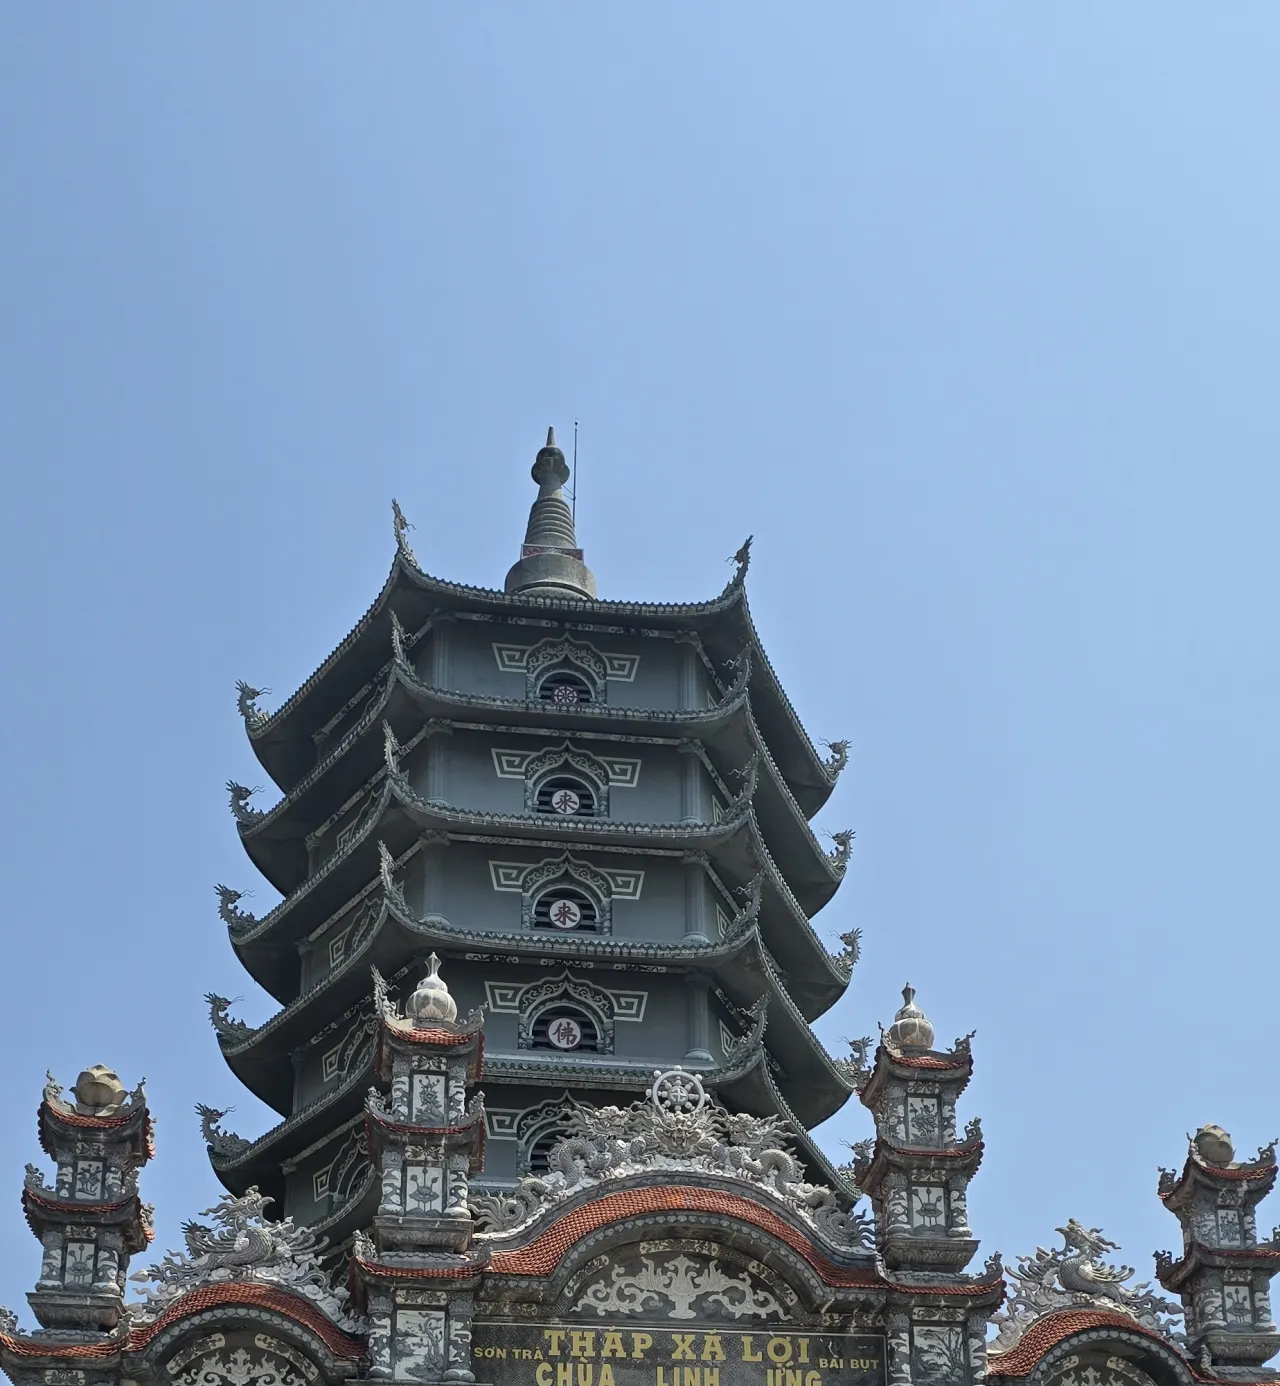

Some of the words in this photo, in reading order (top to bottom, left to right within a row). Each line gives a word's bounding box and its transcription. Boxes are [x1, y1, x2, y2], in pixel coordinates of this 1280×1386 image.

[552, 1021, 578, 1046] 佛
[474, 1346, 507, 1359] SƠN
[512, 1345, 544, 1360] TRÀ
[544, 1326, 653, 1358] THÁP
[741, 1335, 810, 1367] LỢI
